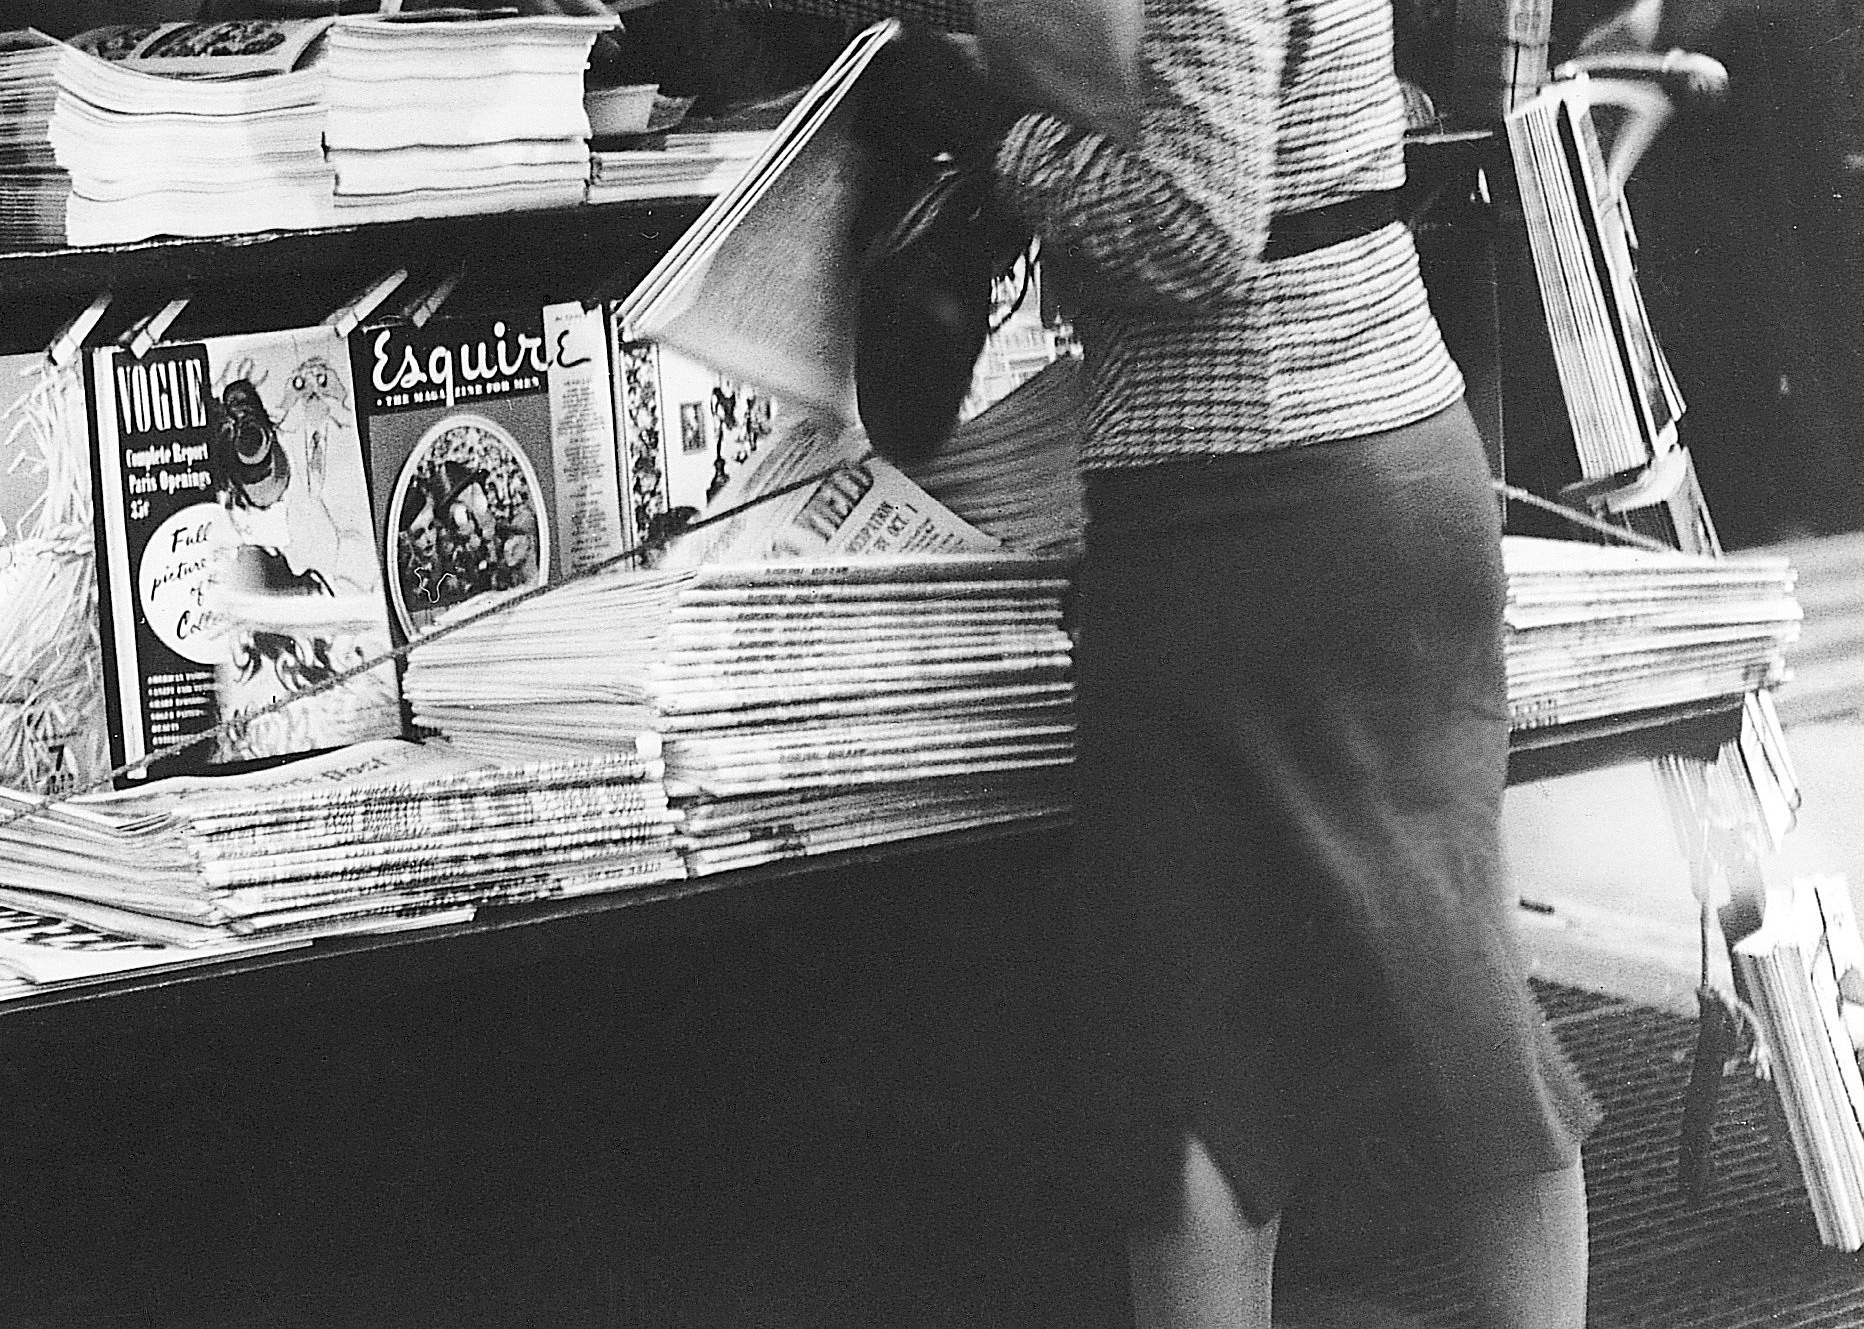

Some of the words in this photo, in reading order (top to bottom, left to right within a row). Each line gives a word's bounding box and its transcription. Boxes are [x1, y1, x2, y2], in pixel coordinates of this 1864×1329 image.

[118, 358, 207, 435] VOGUE
[129, 473, 158, 495] Paris
[159, 471, 212, 495] Openings
[171, 522, 212, 552] Full
